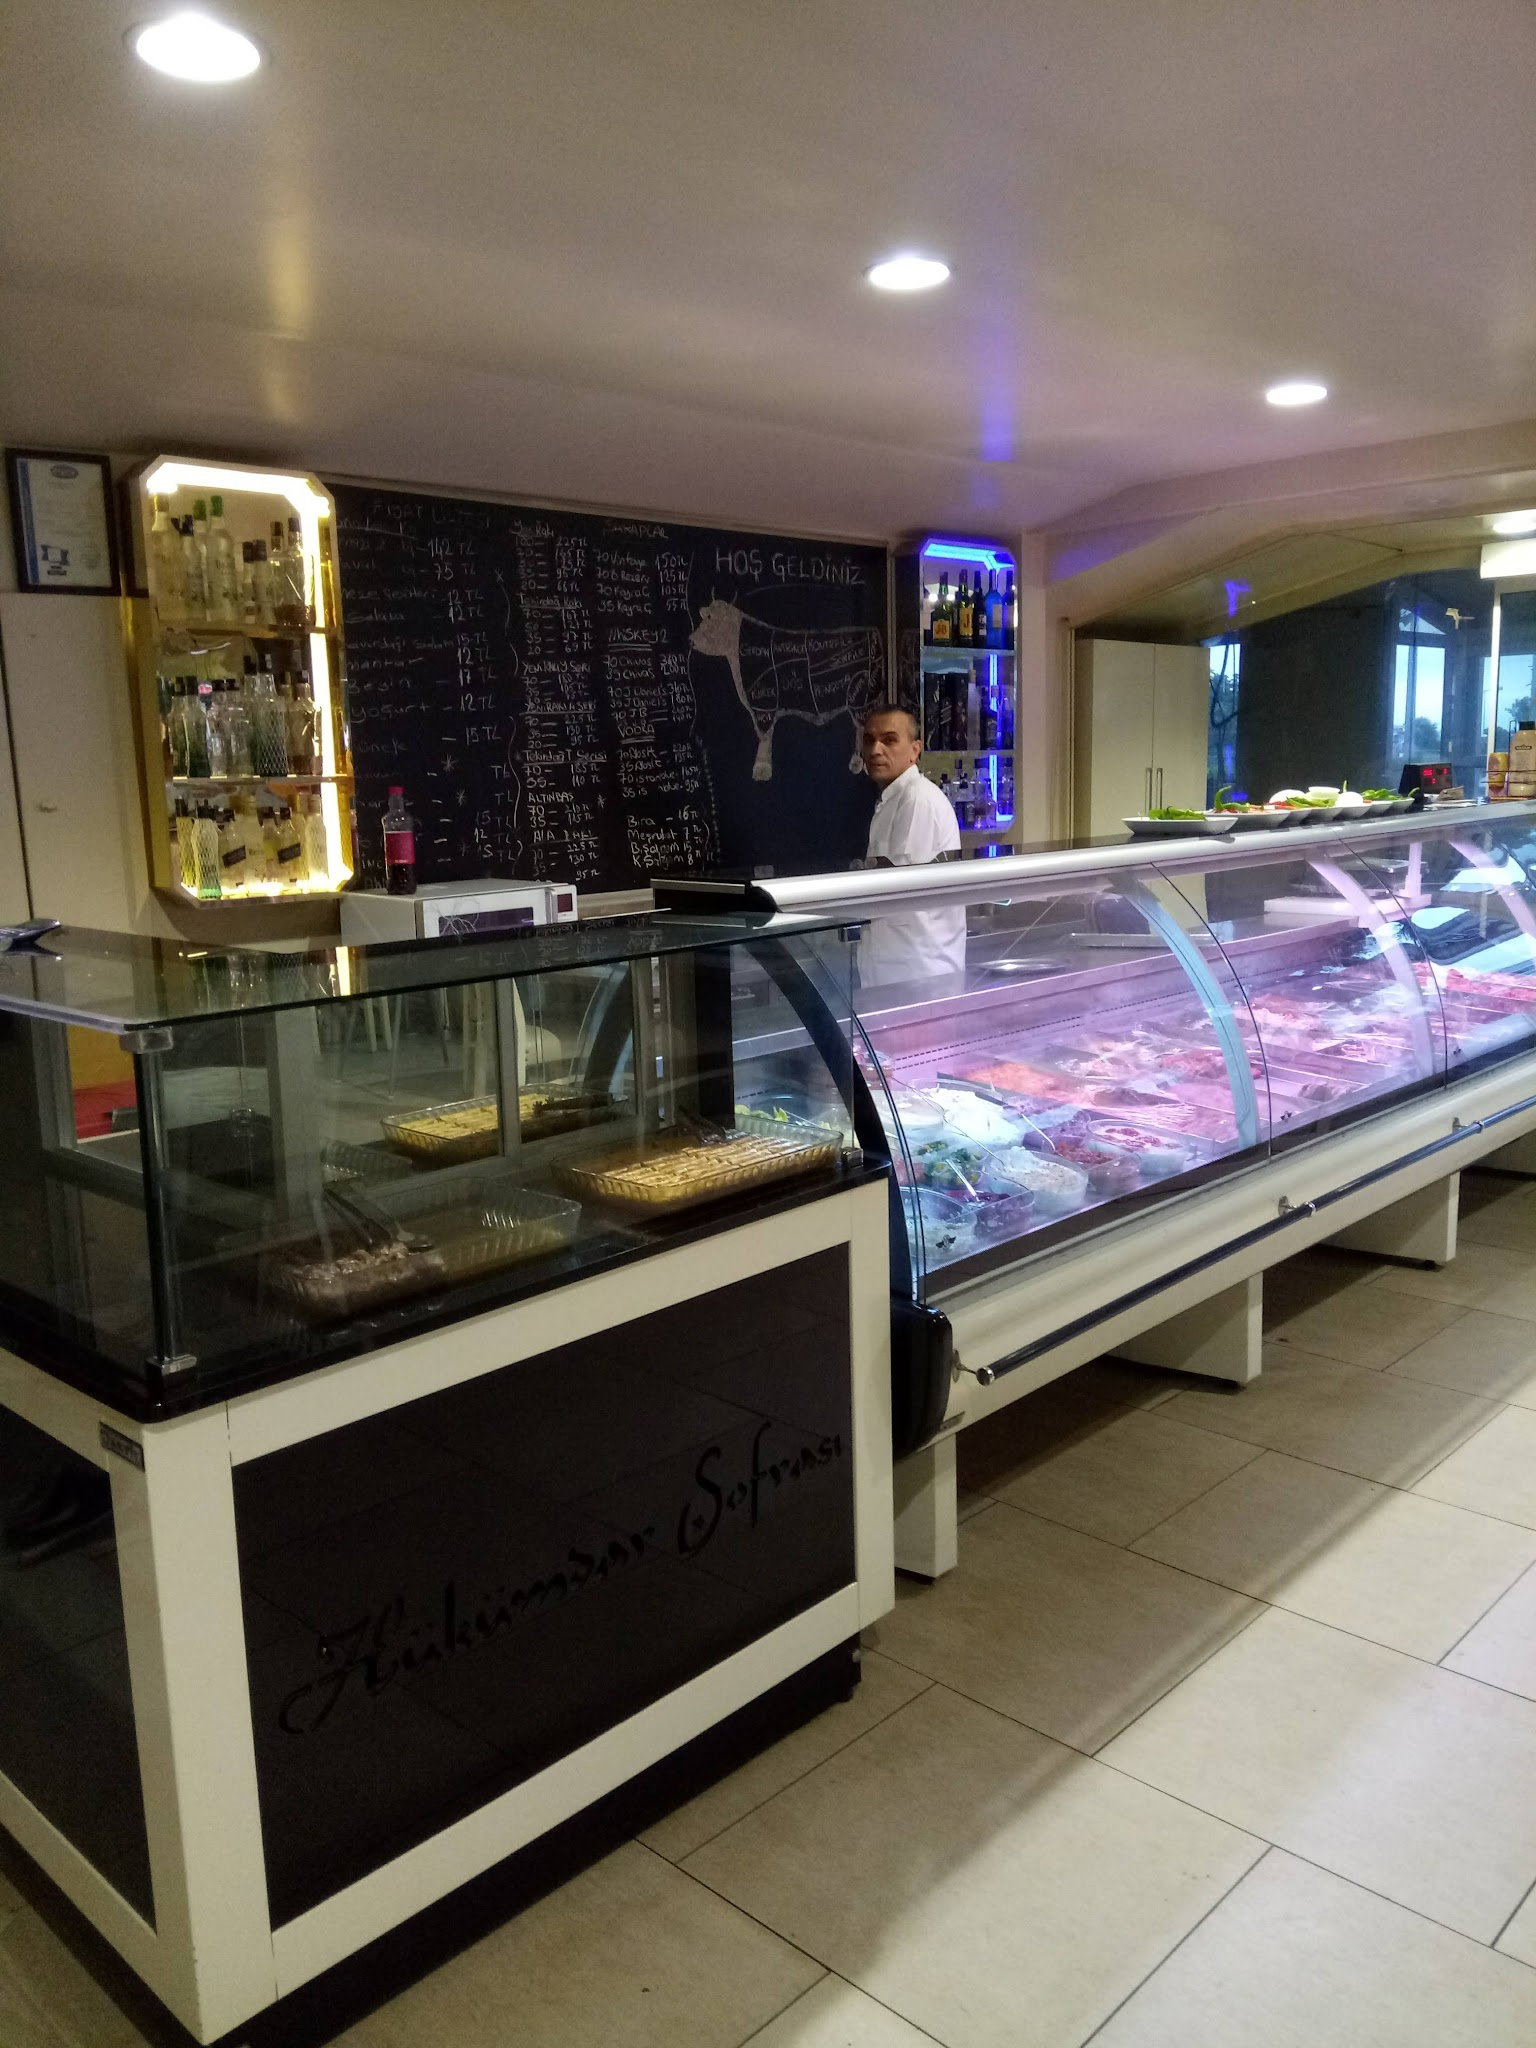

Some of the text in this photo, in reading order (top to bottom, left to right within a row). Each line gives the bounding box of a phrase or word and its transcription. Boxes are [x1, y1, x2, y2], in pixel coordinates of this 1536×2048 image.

[428, 537, 477, 560] 142 TL
[433, 563, 476, 581] 75 TL
[715, 547, 865, 585] HOŞ GELDİNİZ
[465, 588, 485, 601] TL
[466, 606, 485, 618] TL
[474, 631, 488, 644] TL
[457, 647, 494, 666] 12 TL
[458, 669, 471, 687] 17
[460, 693, 476, 711] 12
[478, 696, 495, 710] TL
[466, 726, 500, 747] 15 TL
[528, 741, 542, 750] 20
[490, 763, 509, 780] TL
[521, 764, 541, 776] 70
[526, 776, 547, 789] 35
[616, 772, 634, 785] 70
[494, 790, 512, 806] TL
[622, 786, 636, 799] 35
[527, 804, 545, 816] 70
[627, 815, 656, 828] Bira
[678, 804, 690, 821] 16
[495, 815, 511, 829] TL
[530, 816, 547, 828] 35
[473, 827, 510, 845] 12 TL
[682, 826, 690, 840] 7
[497, 849, 514, 864] TL
[687, 853, 694, 866] 8
[279, 1421, 842, 1734] Hükümdar Sofrası
